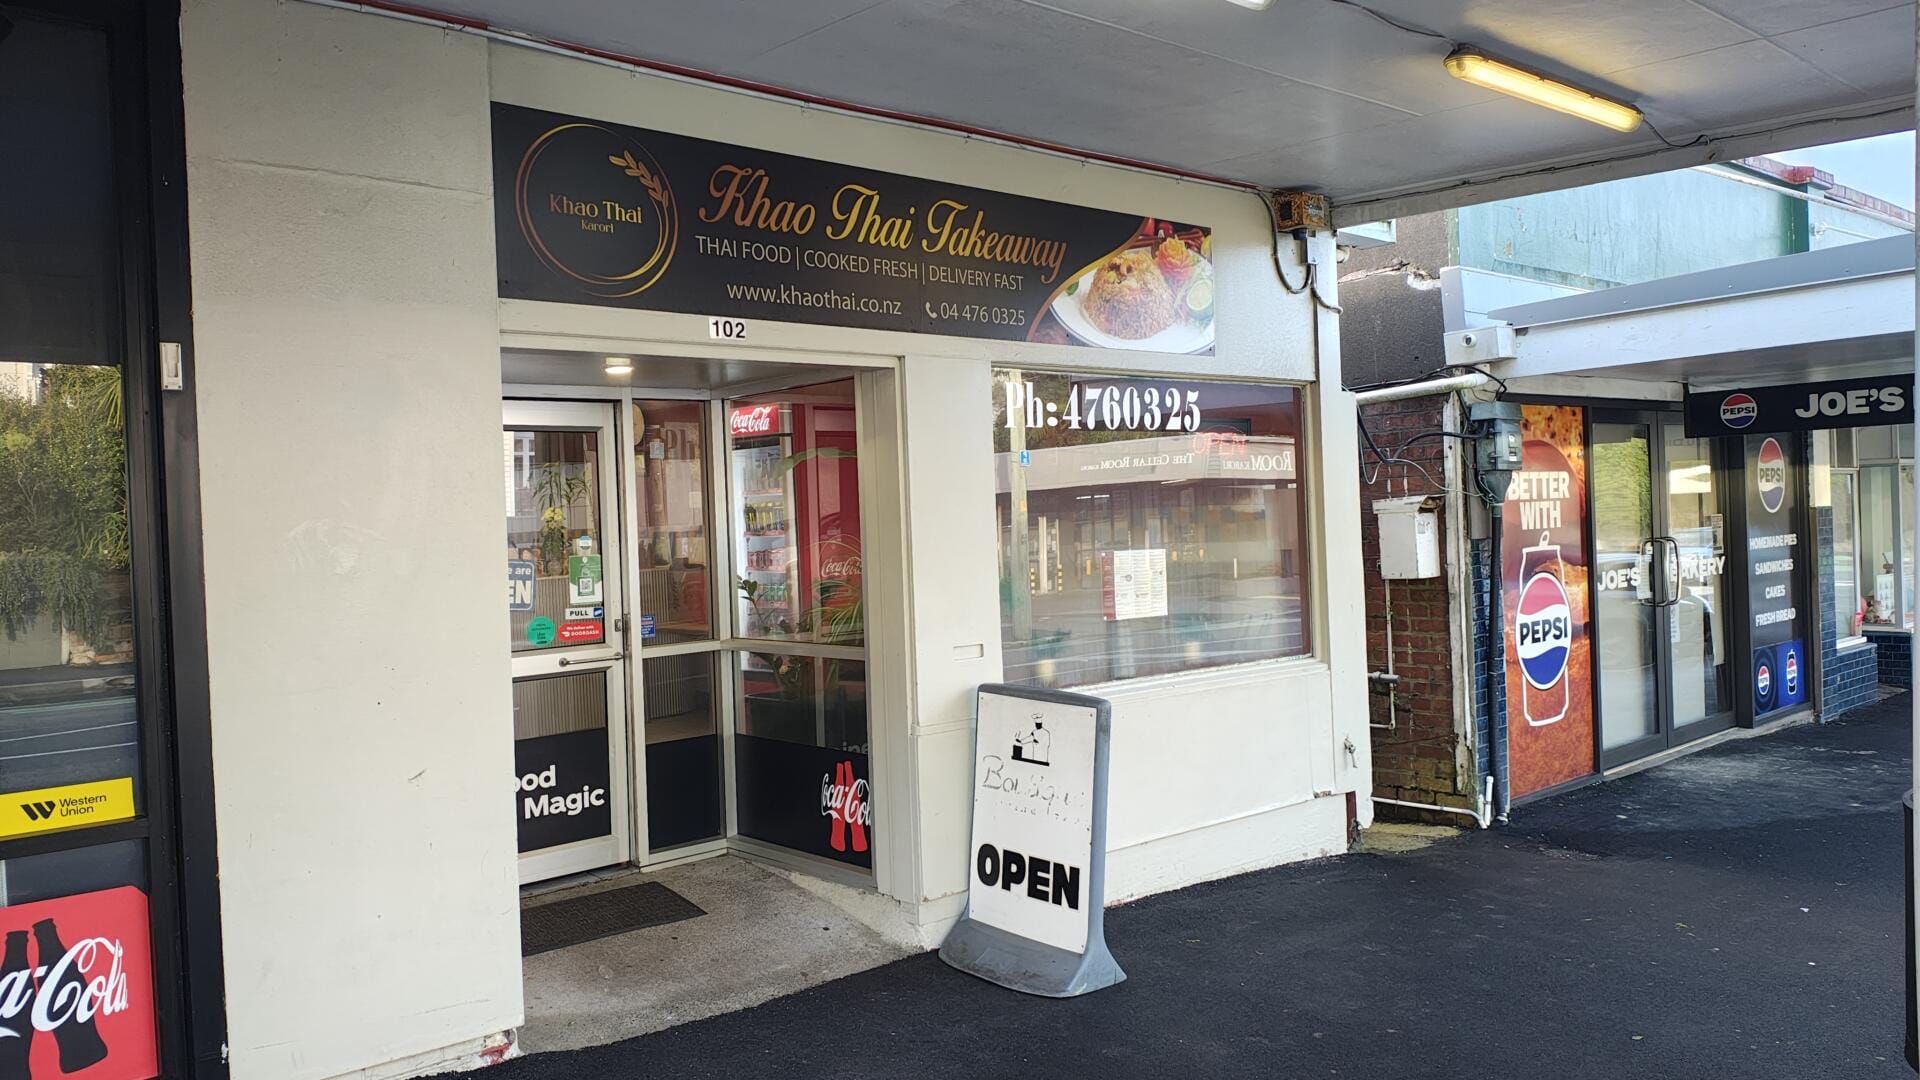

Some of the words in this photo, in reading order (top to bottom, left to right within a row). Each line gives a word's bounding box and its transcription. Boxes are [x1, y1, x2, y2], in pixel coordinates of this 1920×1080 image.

[549, 194, 598, 217] Khao
[602, 201, 643, 224] Thai
[699, 164, 816, 236] Khao
[826, 184, 914, 249] Thai
[921, 199, 1068, 284] Takeaway
[695, 236, 737, 259] THAI
[743, 241, 792, 264] FOOD
[804, 250, 870, 273] COOKED
[873, 259, 918, 279] FRESH
[929, 268, 992, 287] DELIVERY
[994, 273, 1025, 291] FAST
[727, 284, 902, 315] www.khaothai.co.nz
[940, 302, 963, 320] 04
[965, 303, 990, 322] 476
[992, 305, 1026, 326] 0325
[712, 320, 746, 339] 102
[1722, 405, 1756, 417] PEPSI
[1795, 386, 1905, 418] JOE'S
[730, 406, 771, 434] Coca-Cola
[1508, 471, 1570, 500] BETTER
[1759, 465, 1785, 484] PEPSI
[1519, 500, 1562, 530] WITH
[1750, 534, 1784, 550] HOMEMADE
[1785, 533, 1797, 546] PIES
[1597, 566, 1641, 591] JOE'S
[1755, 559, 1794, 575] SANDWICHES
[1765, 585, 1786, 599] CAKES
[1755, 611, 1776, 627] FRESH
[1776, 608, 1796, 623] BREAD
[1519, 617, 1569, 647] PEPSI
[59, 793, 107, 808] Western
[60, 804, 94, 818] Union
[524, 785, 605, 819] Magic
[821, 773, 871, 826] Coca-Col
[977, 843, 1080, 910] OPEN
